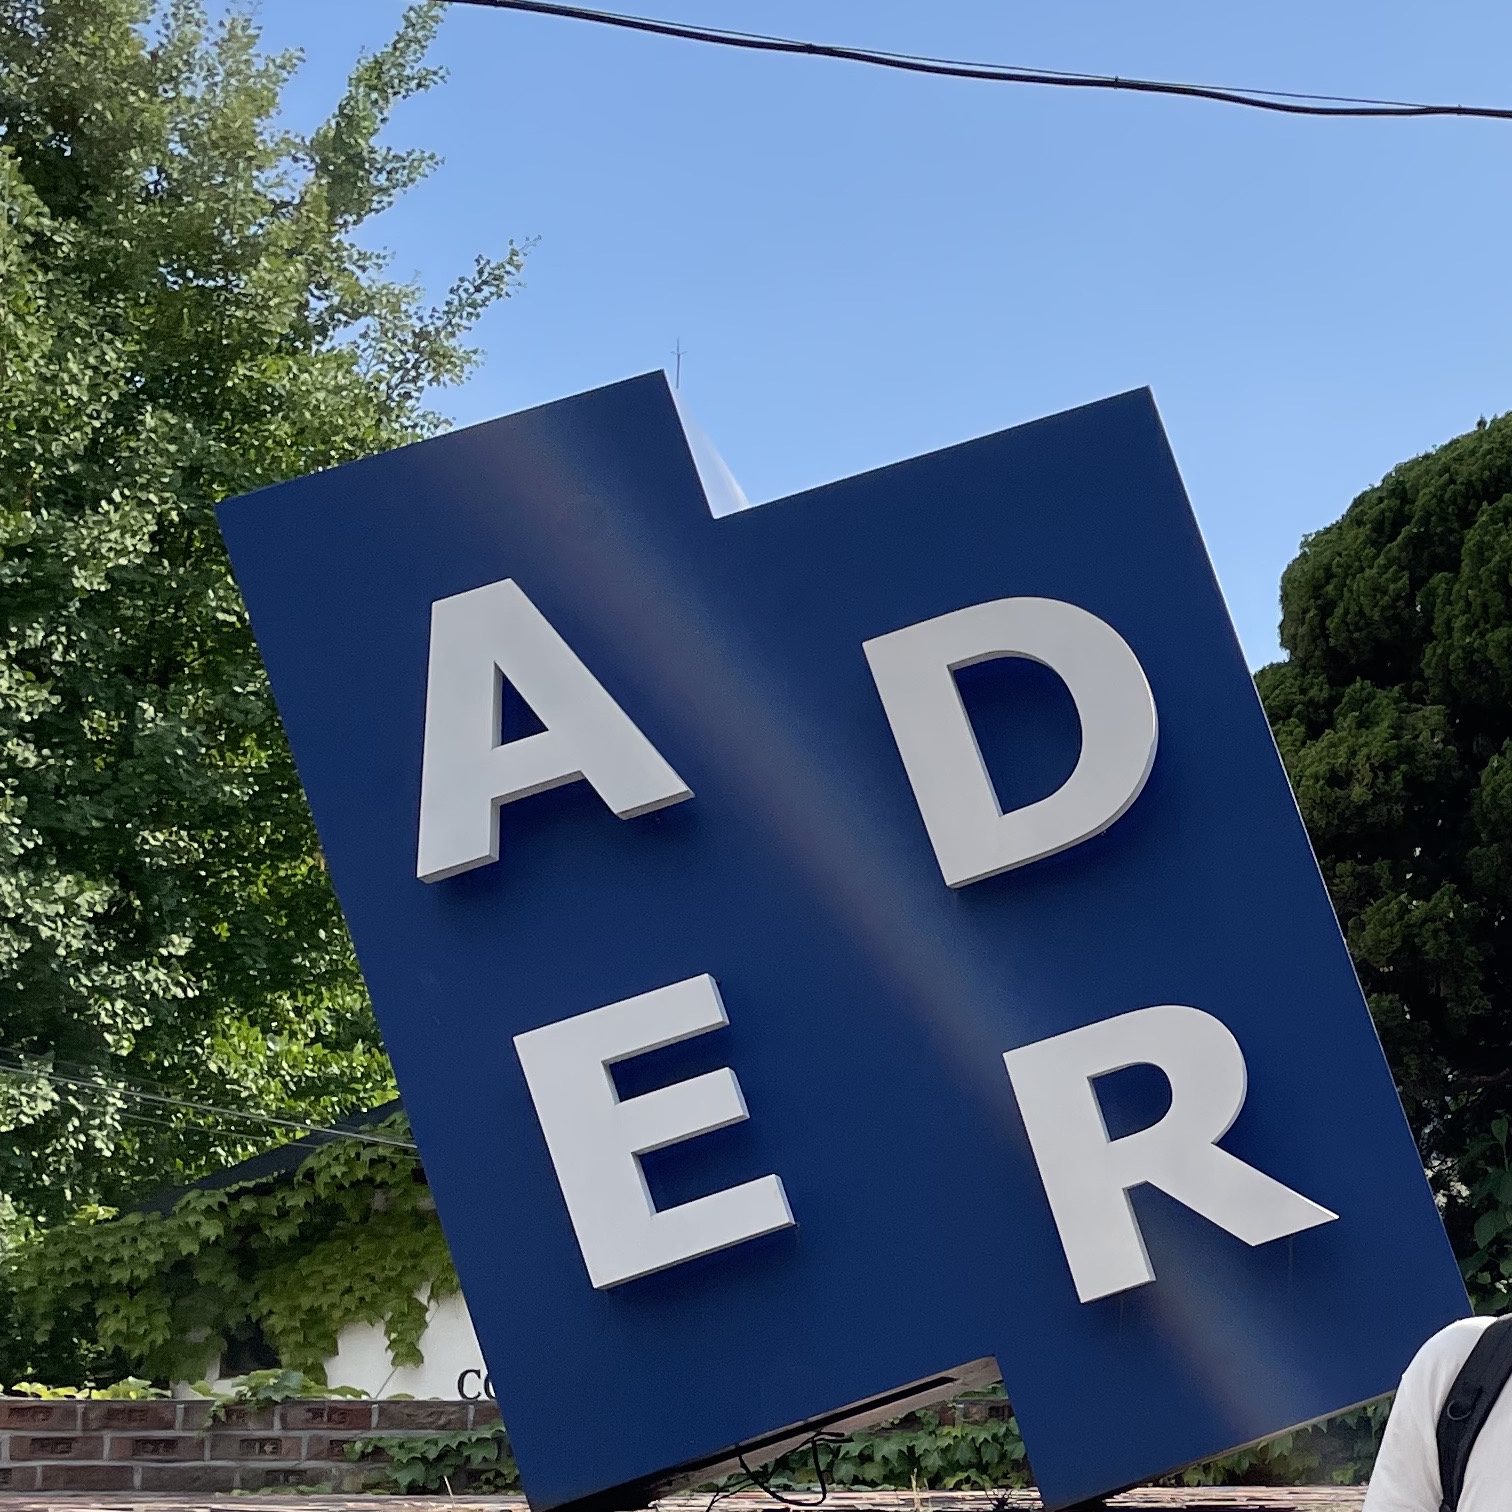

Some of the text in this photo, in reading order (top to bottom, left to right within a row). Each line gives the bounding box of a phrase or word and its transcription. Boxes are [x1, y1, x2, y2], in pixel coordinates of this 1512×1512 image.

[416, 577, 1159, 889] A D
[512, 972, 1340, 1304] E R
